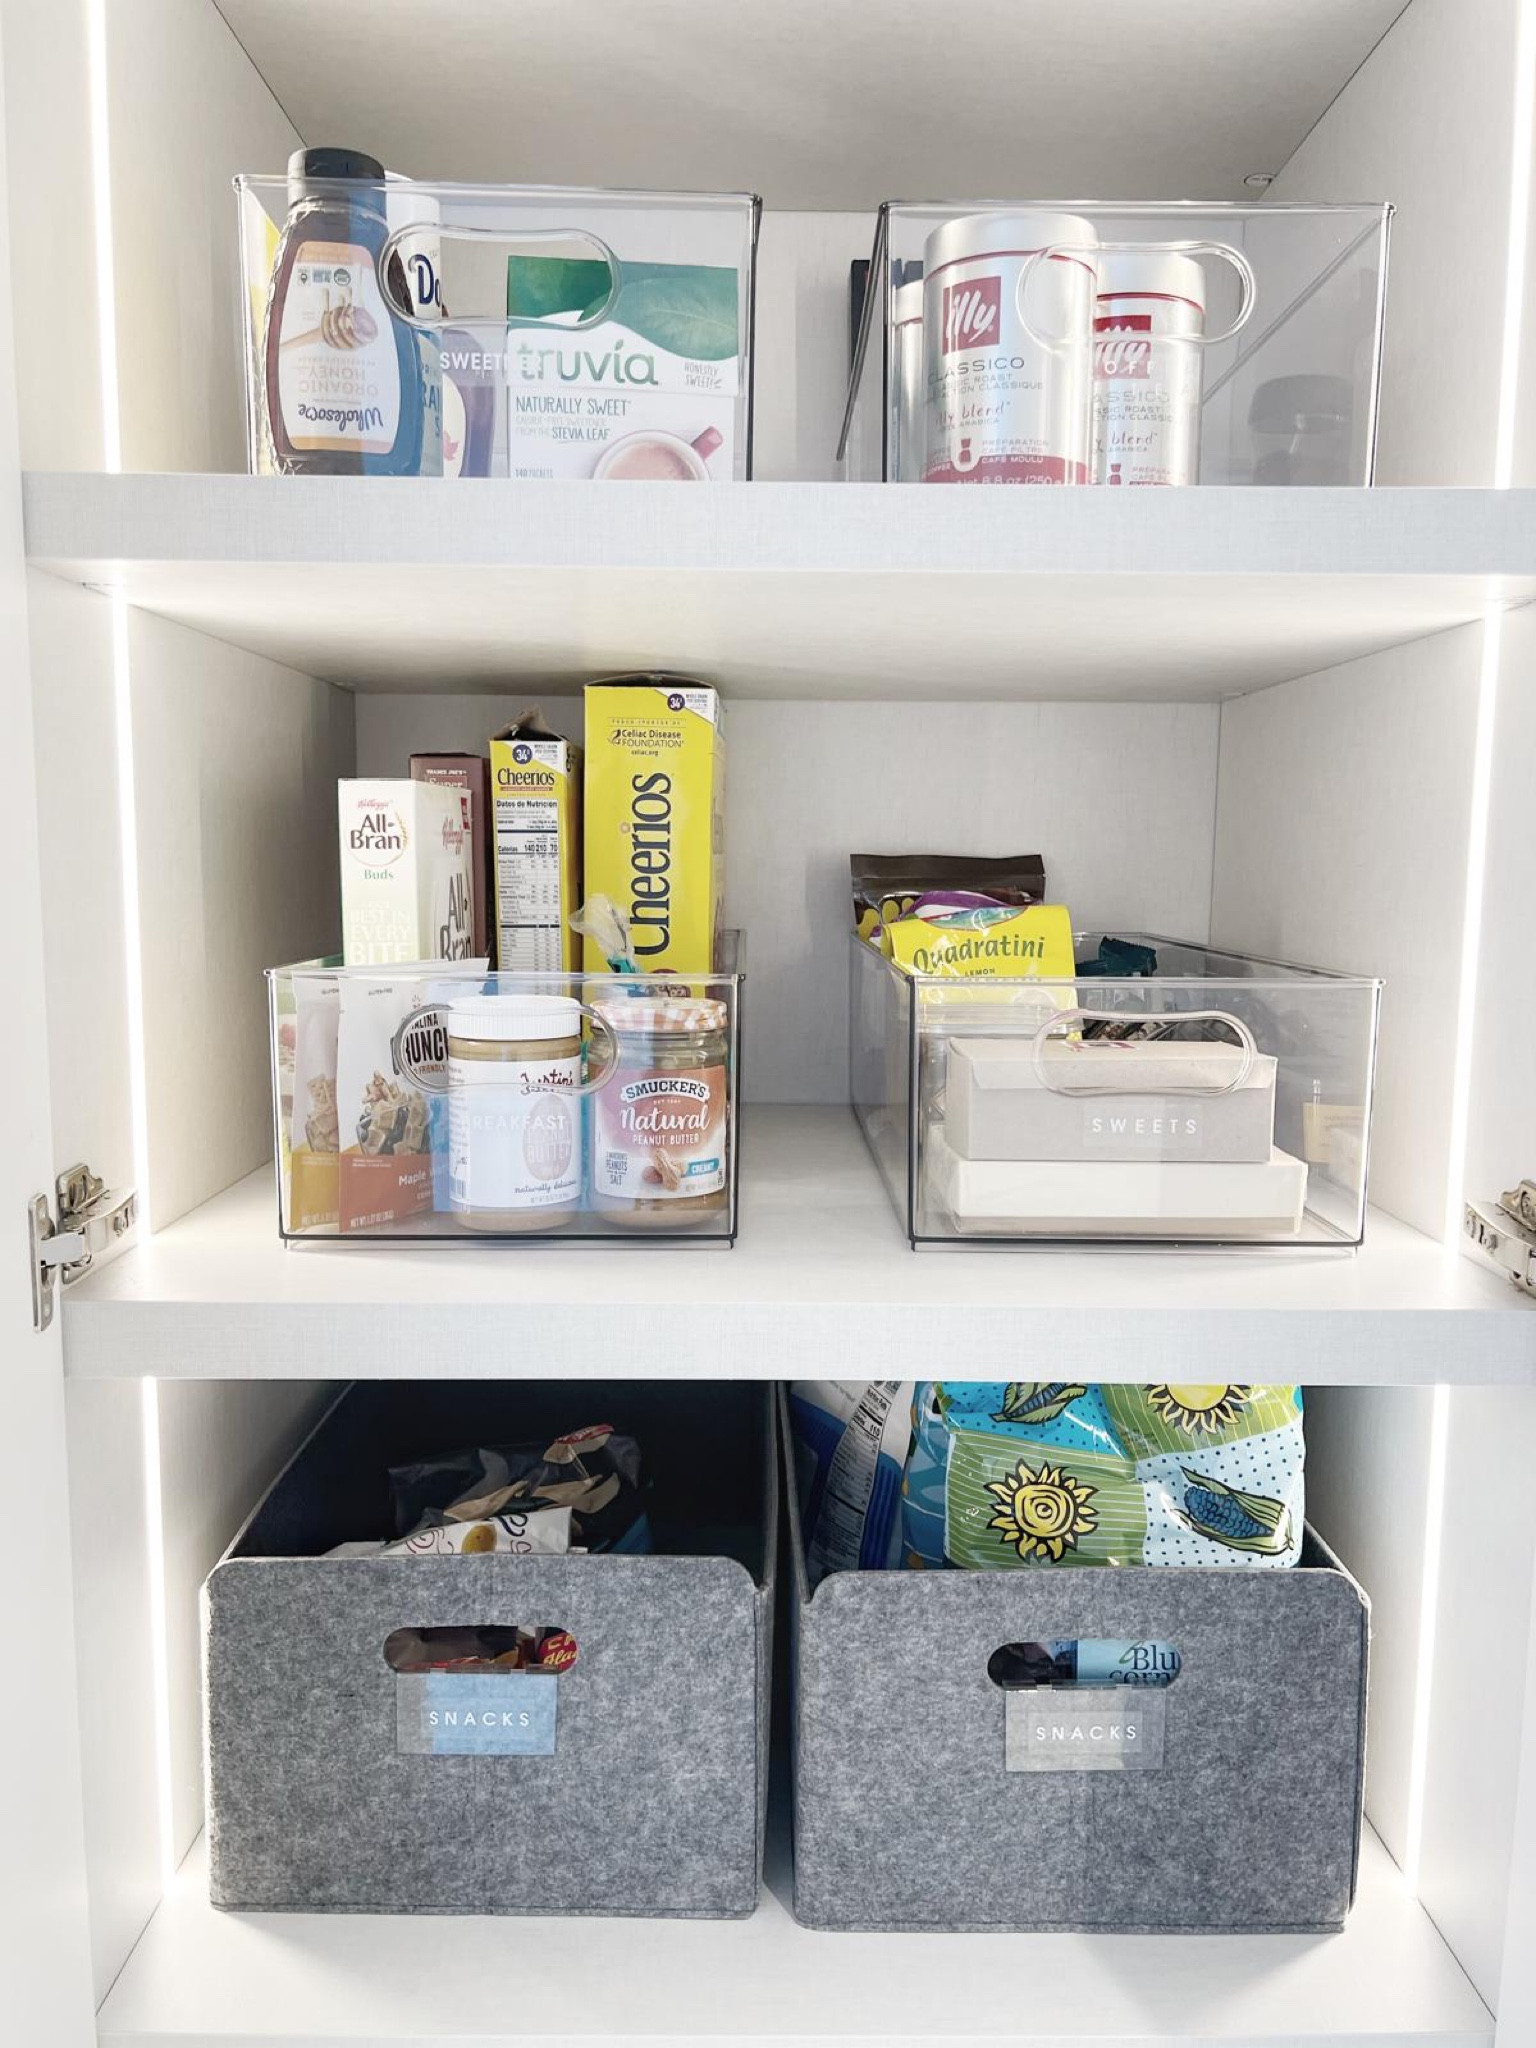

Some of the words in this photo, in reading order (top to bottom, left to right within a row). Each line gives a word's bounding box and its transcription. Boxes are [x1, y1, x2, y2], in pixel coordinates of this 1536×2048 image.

[946, 289, 996, 343] illy
[440, 351, 509, 372] SWEET
[516, 396, 582, 415] NATURALLY
[586, 398, 627, 417] SWEET
[961, 401, 1006, 420] blend
[552, 426, 584, 440] STEVIA
[587, 428, 610, 441] LEAF
[621, 729, 647, 739] Celiac
[649, 730, 682, 739] Disease
[621, 739, 682, 748] FOUNDATION
[497, 767, 555, 787] Cheerios
[496, 800, 515, 808] Datos
[517, 800, 525, 808] de
[350, 828, 402, 850] Bran
[630, 772, 672, 957] Cheerios
[364, 869, 395, 880] Buds
[913, 934, 1046, 975] Quadratini
[625, 1079, 707, 1100] SMUCKER'S
[620, 1103, 710, 1133] Natural
[1092, 1117, 1198, 1135] SWEETS
[632, 1133, 665, 1146] PEANUT
[669, 1133, 699, 1145] BUTTER
[398, 1169, 427, 1188] Maple
[429, 1711, 530, 1727] SNACKS
[1036, 1726, 1137, 1741] SNACKS
